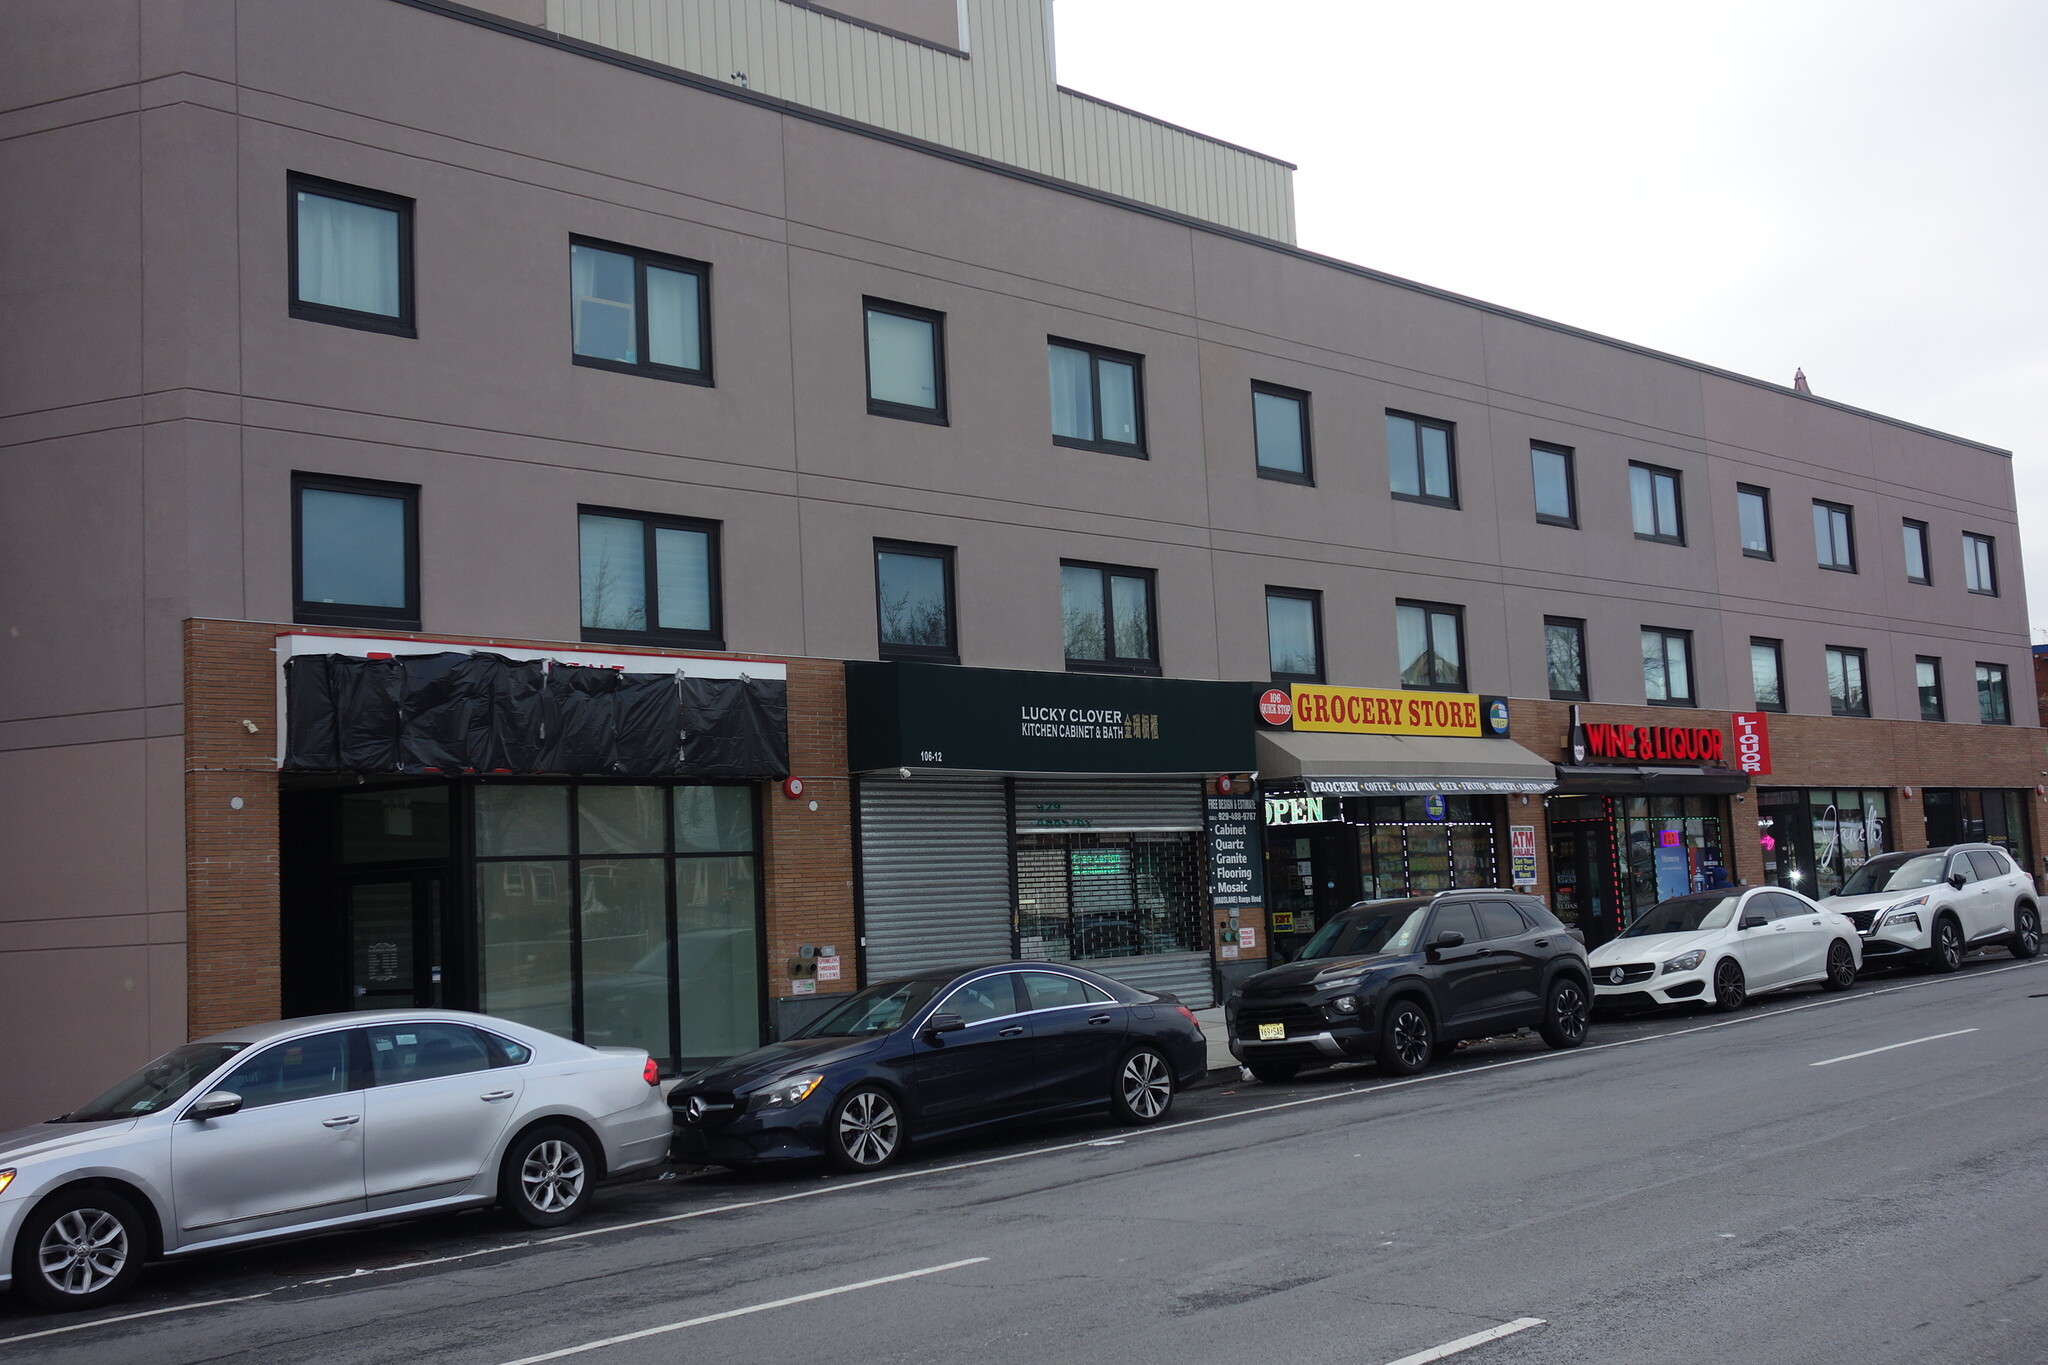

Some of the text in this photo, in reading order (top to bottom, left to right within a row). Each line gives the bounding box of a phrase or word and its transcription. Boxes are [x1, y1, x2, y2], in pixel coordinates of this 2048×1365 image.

[1270, 693, 1281, 703] 106
[1021, 706, 1122, 724] LUCKY CLOVER
[1277, 704, 1291, 715] STOP
[1297, 693, 1403, 726] GROCERY
[1408, 699, 1477, 728] STORE
[1021, 722, 1124, 739] KITCHEN CABINET & BATH
[1583, 723, 1723, 760] WINE & LIQUOR
[1738, 716, 1761, 772] LIQUOR
[920, 751, 943, 762] 106-12
[1311, 781, 1360, 793] GROCERY
[1364, 782, 1394, 792] COFFEE
[1396, 782, 1415, 792] COLD
[1415, 782, 1438, 791] DRINK
[1440, 782, 1460, 791] BEER
[1461, 781, 1486, 791] FRUITS
[1488, 782, 1518, 791] GROCERY
[1519, 782, 1541, 791] LOTTO
[1208, 799, 1218, 809] FREE
[1218, 799, 1233, 809] DESIGN
[1238, 799, 1256, 809] ESTIMATE
[1214, 823, 1247, 835] Cabinet
[1215, 838, 1245, 851] Quartz
[1512, 831, 1534, 847] ATM
[1216, 852, 1248, 864] Granite
[1217, 866, 1252, 880] Flooring
[1217, 881, 1248, 893] Mosaic
